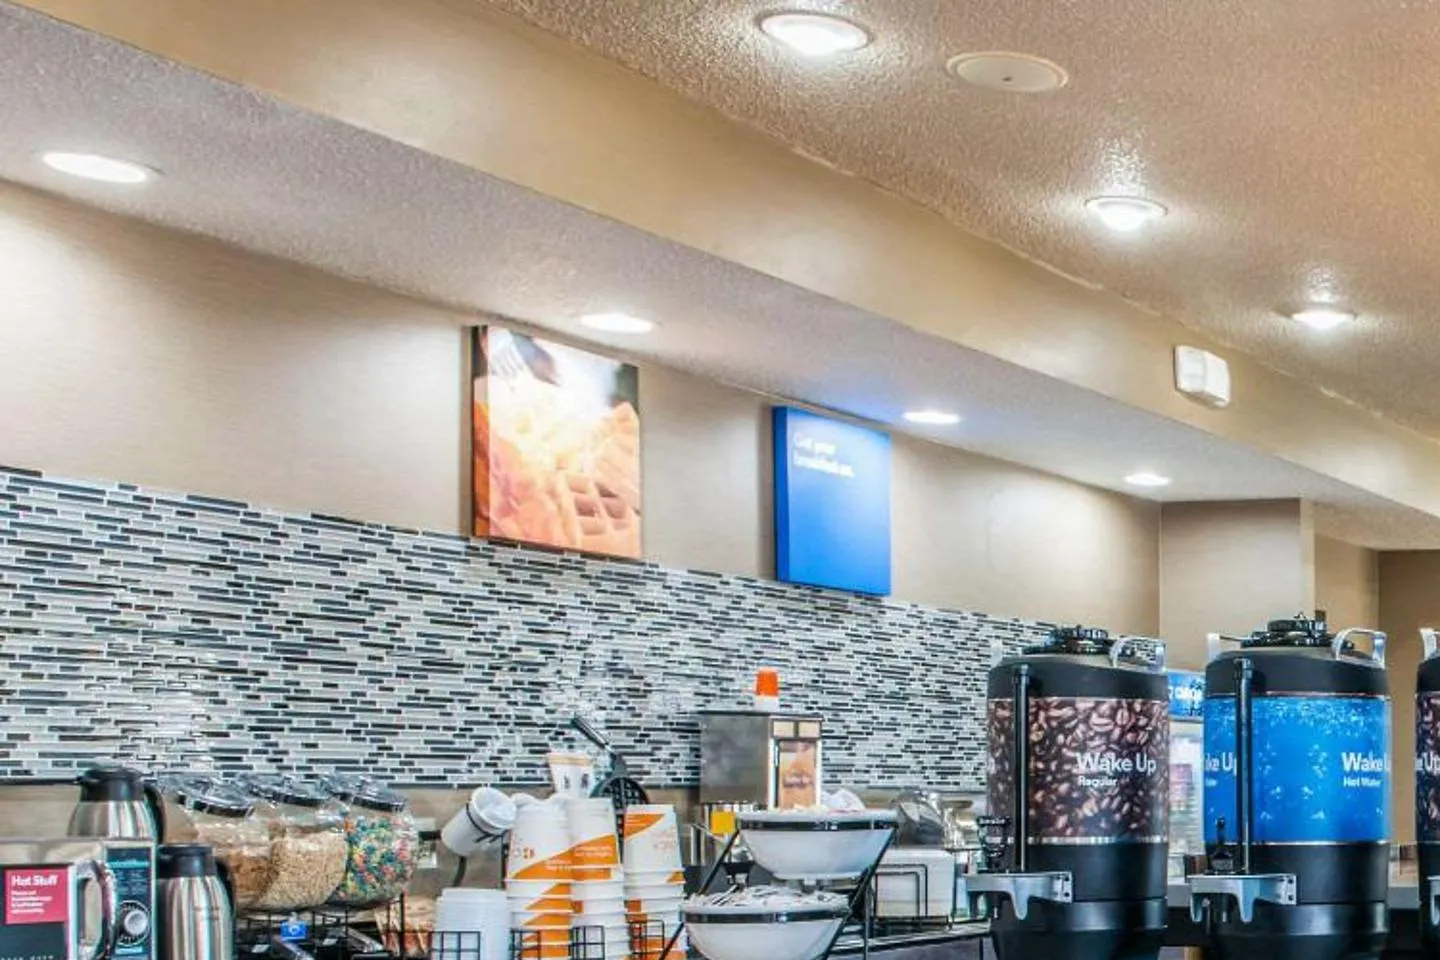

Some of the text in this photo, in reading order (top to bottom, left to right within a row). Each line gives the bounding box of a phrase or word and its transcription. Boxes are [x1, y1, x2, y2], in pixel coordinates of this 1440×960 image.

[1076, 752, 1157, 776] Wake Up
[1341, 752, 1383, 772] Wake
